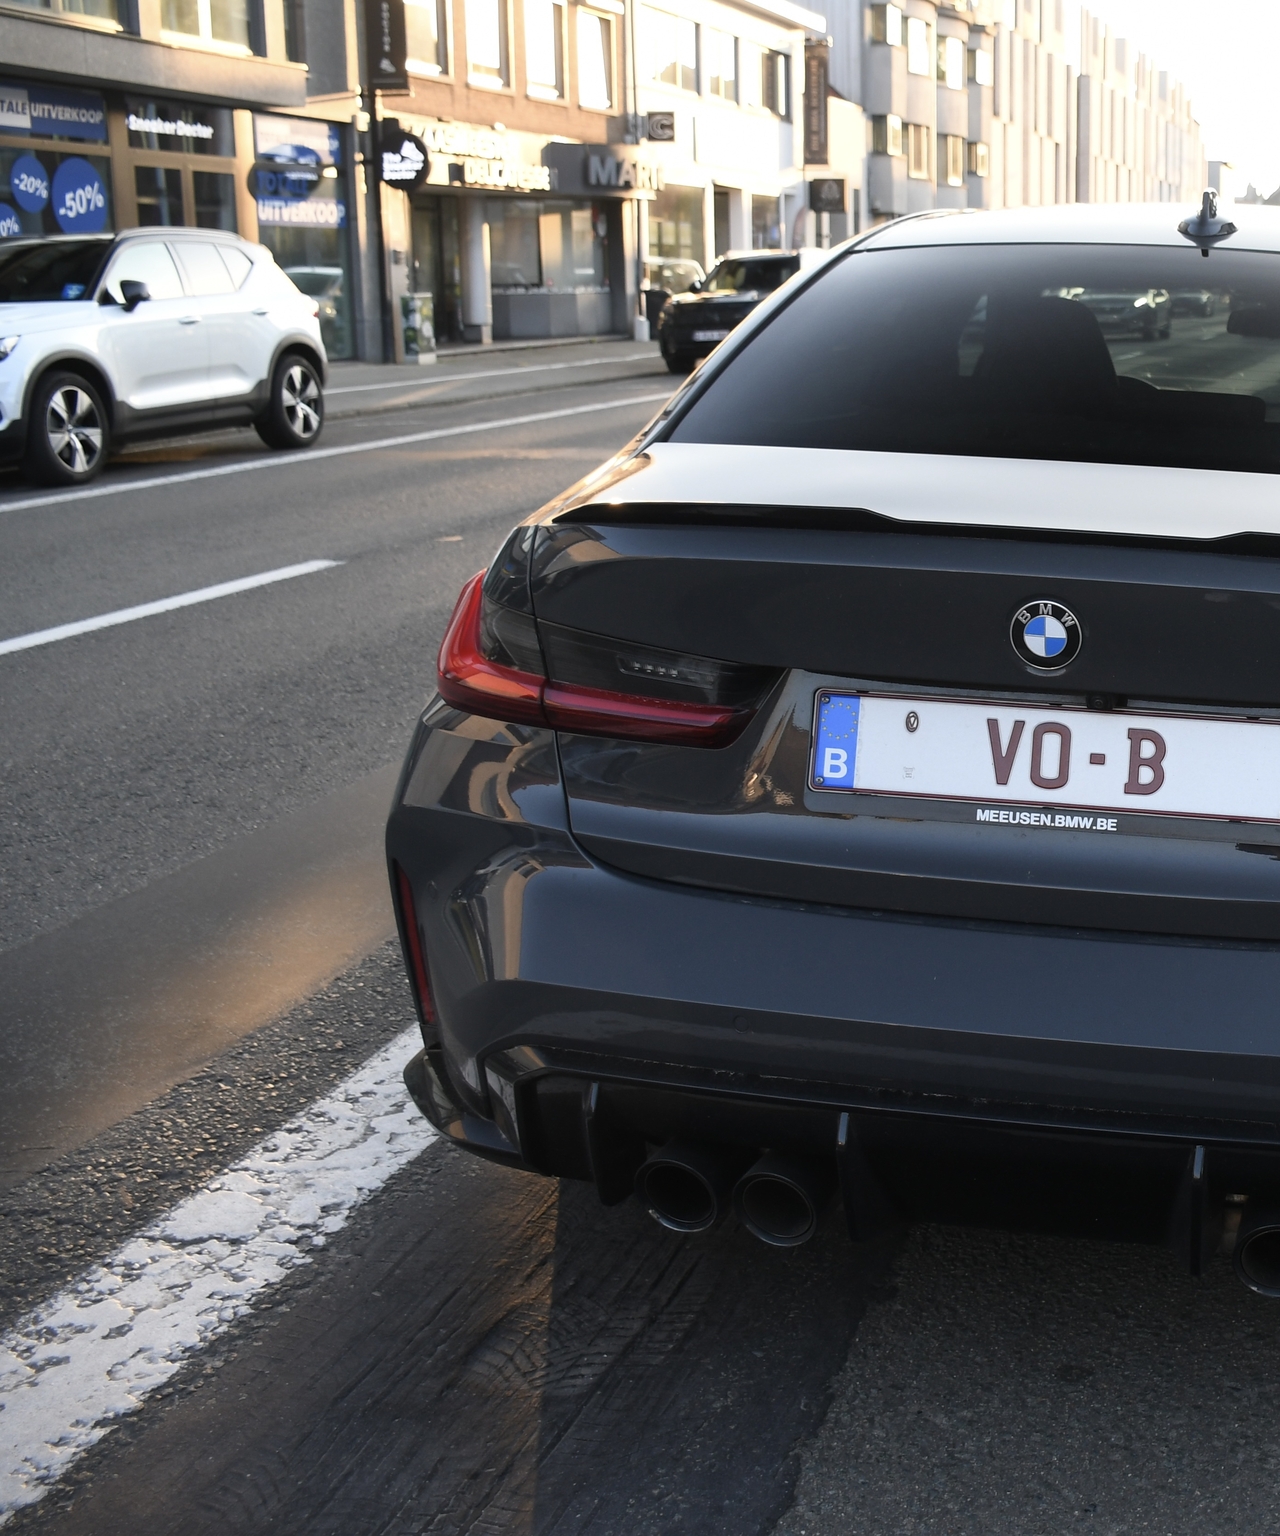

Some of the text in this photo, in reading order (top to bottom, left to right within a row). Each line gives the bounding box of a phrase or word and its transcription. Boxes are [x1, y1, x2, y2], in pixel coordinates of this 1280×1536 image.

[31, 102, 104, 124] UITVERKOOP
[14, 172, 48, 199] -20%
[59, 181, 105, 218] -50%
[258, 199, 345, 224] UITVERKOOP
[1017, 603, 1076, 628] BMW
[822, 747, 848, 780] B
[975, 808, 1118, 832] MEEUSEN.BMW.BE
